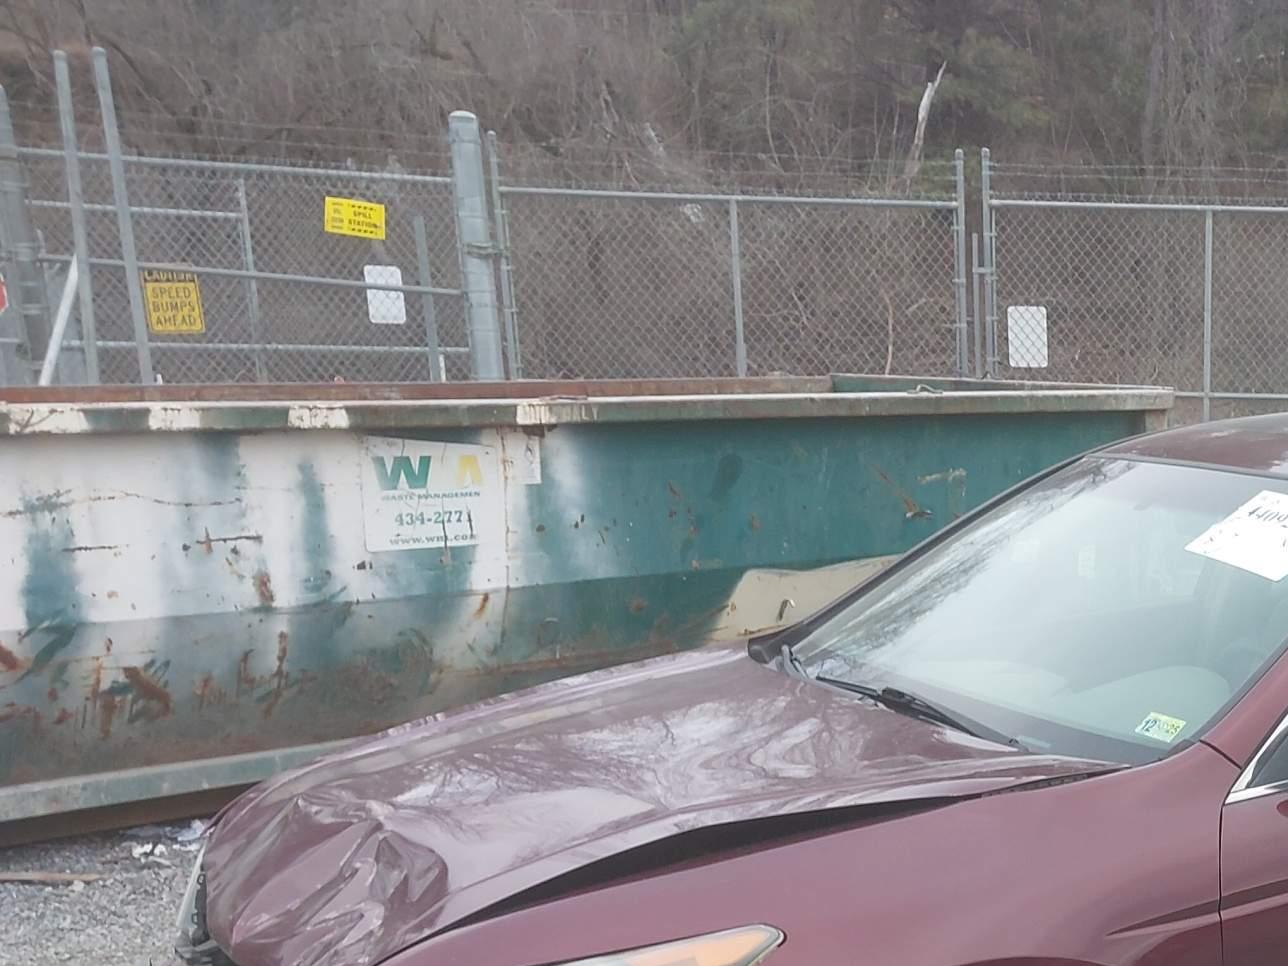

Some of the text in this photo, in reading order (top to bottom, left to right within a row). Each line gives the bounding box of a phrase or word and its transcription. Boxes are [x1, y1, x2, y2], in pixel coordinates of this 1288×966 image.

[152, 287, 191, 299] SPEED
[152, 301, 195, 313] BUMPS
[156, 314, 197, 328] AHEAD
[1142, 719, 1158, 732] 12
